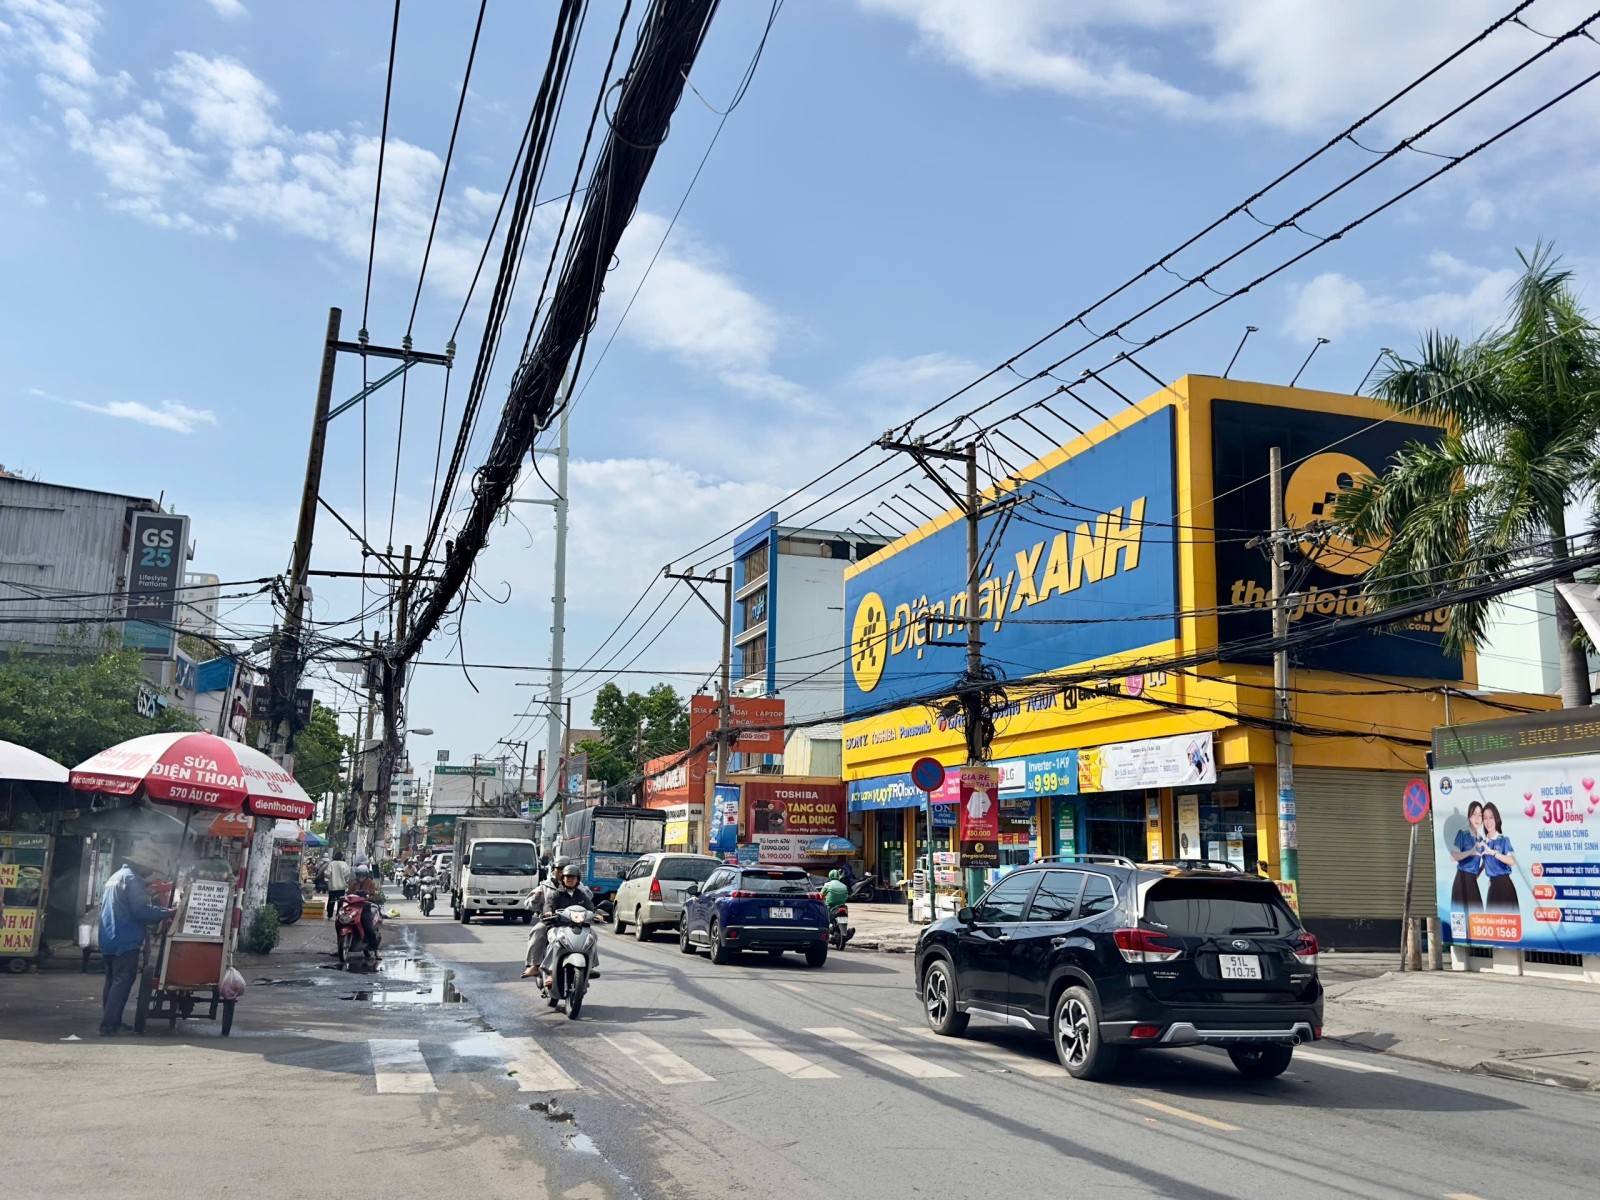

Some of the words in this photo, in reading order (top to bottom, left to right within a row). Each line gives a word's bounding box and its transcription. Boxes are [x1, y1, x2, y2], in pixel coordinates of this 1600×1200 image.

[142, 528, 174, 548] GS
[140, 547, 172, 568] 25
[138, 580, 168, 588] Platform
[139, 574, 168, 582] Lifestyle
[890, 593, 945, 660] Điện
[1010, 496, 1147, 613] XANH
[1026, 691, 1057, 712] AQUA
[872, 728, 897, 744] TOSHIBA
[899, 720, 932, 739] Panasonic
[846, 734, 869, 750] SONY
[183, 754, 218, 771] SỬA
[1028, 760, 1052, 772] Inverter
[151, 763, 191, 782] ĐIỆN
[195, 770, 246, 790] THOẠI
[262, 768, 296, 785] THOẠI
[1005, 768, 1015, 780] LG
[1034, 772, 1058, 794] 9,99
[170, 786, 187, 799] 570
[189, 787, 202, 800] ÂU
[204, 791, 220, 803] CƠ
[775, 790, 818, 799] TOSHIBA
[1540, 787, 1554, 798] HỌC
[255, 799, 306, 815] dienthoaivui
[1542, 799, 1564, 823] 30
[789, 815, 807, 824] GIA
[1584, 842, 1599, 850] SINH
[20, 912, 35, 929] MÌ
[1472, 926, 1494, 937] 1800
[1496, 927, 1517, 938] 1568
[1230, 956, 1248, 967] 51L
[1225, 967, 1257, 978] 710.75
